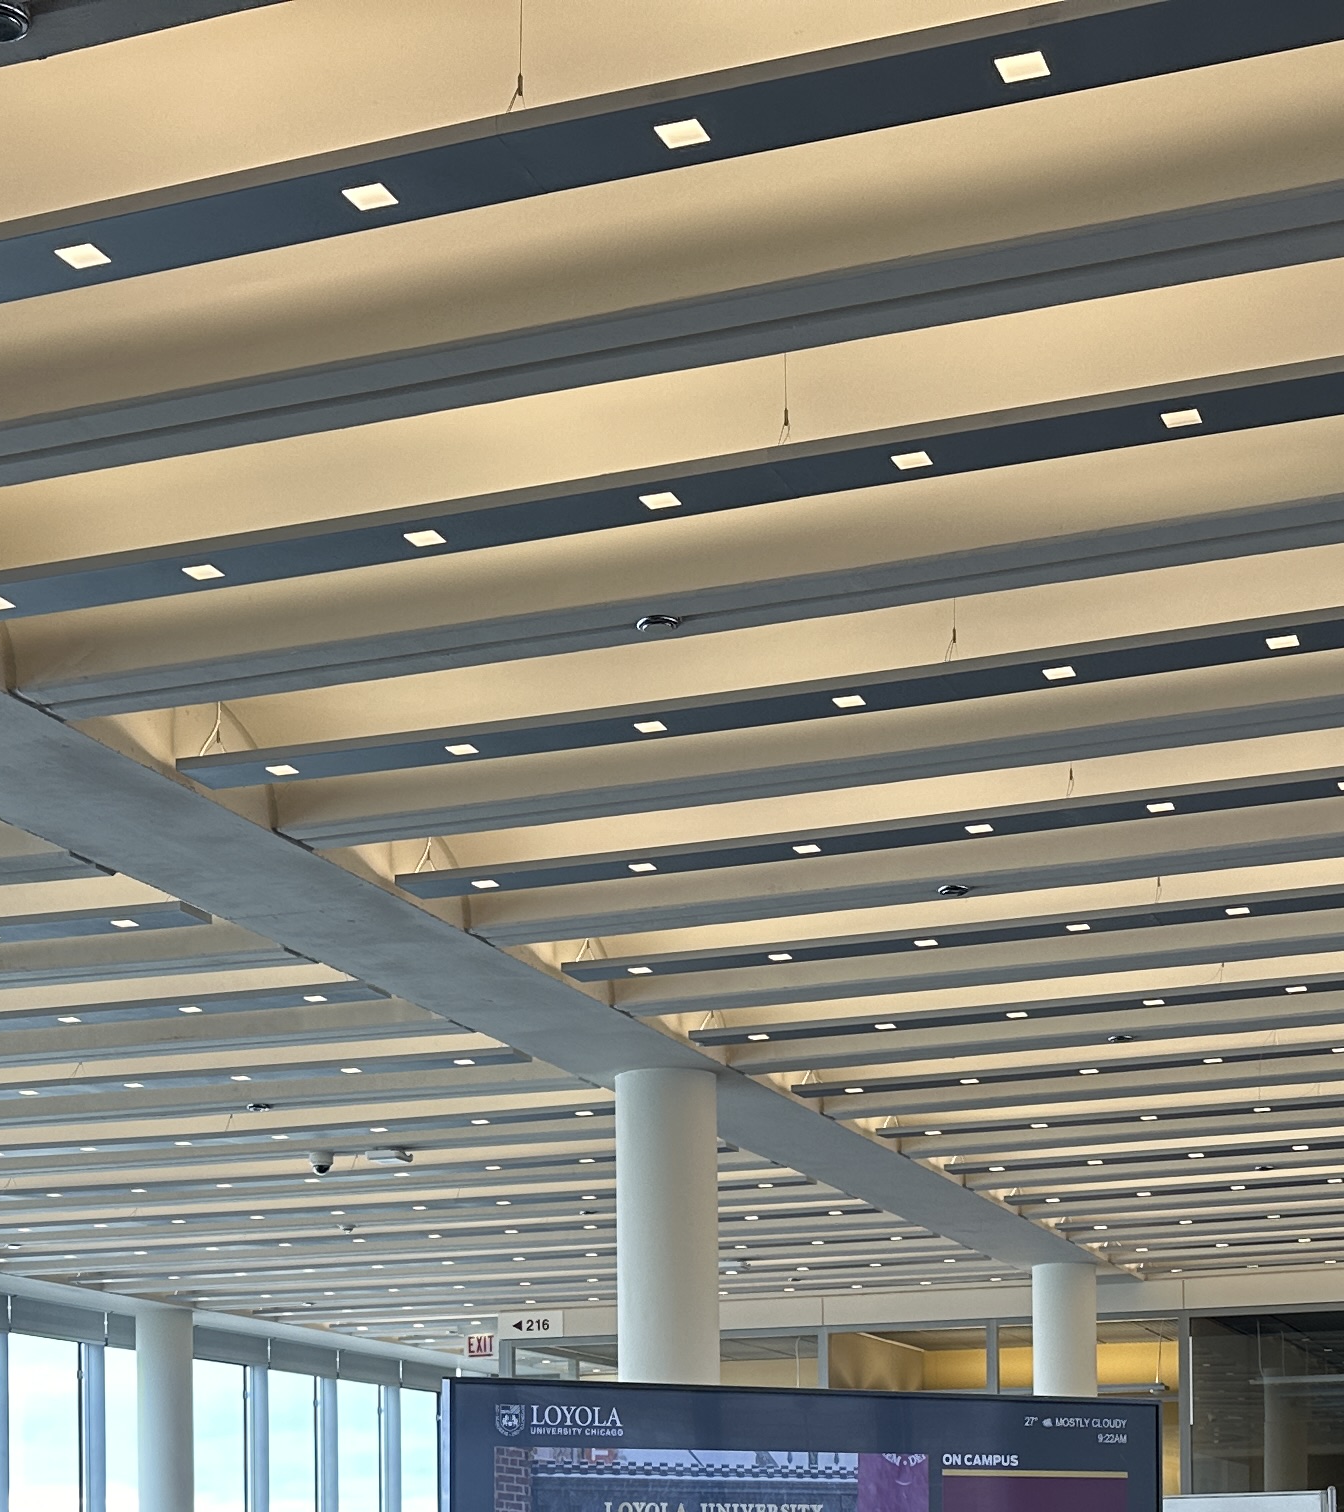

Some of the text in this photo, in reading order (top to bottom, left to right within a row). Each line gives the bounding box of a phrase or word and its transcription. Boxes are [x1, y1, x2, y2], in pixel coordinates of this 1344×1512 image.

[526, 1319, 550, 1332] 216
[468, 1335, 494, 1353] EXIT
[531, 1404, 623, 1427] LOYOLA
[1056, 1418, 1090, 1428] MOSTLY
[1091, 1418, 1127, 1429] CLOUDY
[531, 1426, 624, 1437] UNIVERSITY CHICAGO
[942, 1453, 1019, 1467] ON CAMPUS
